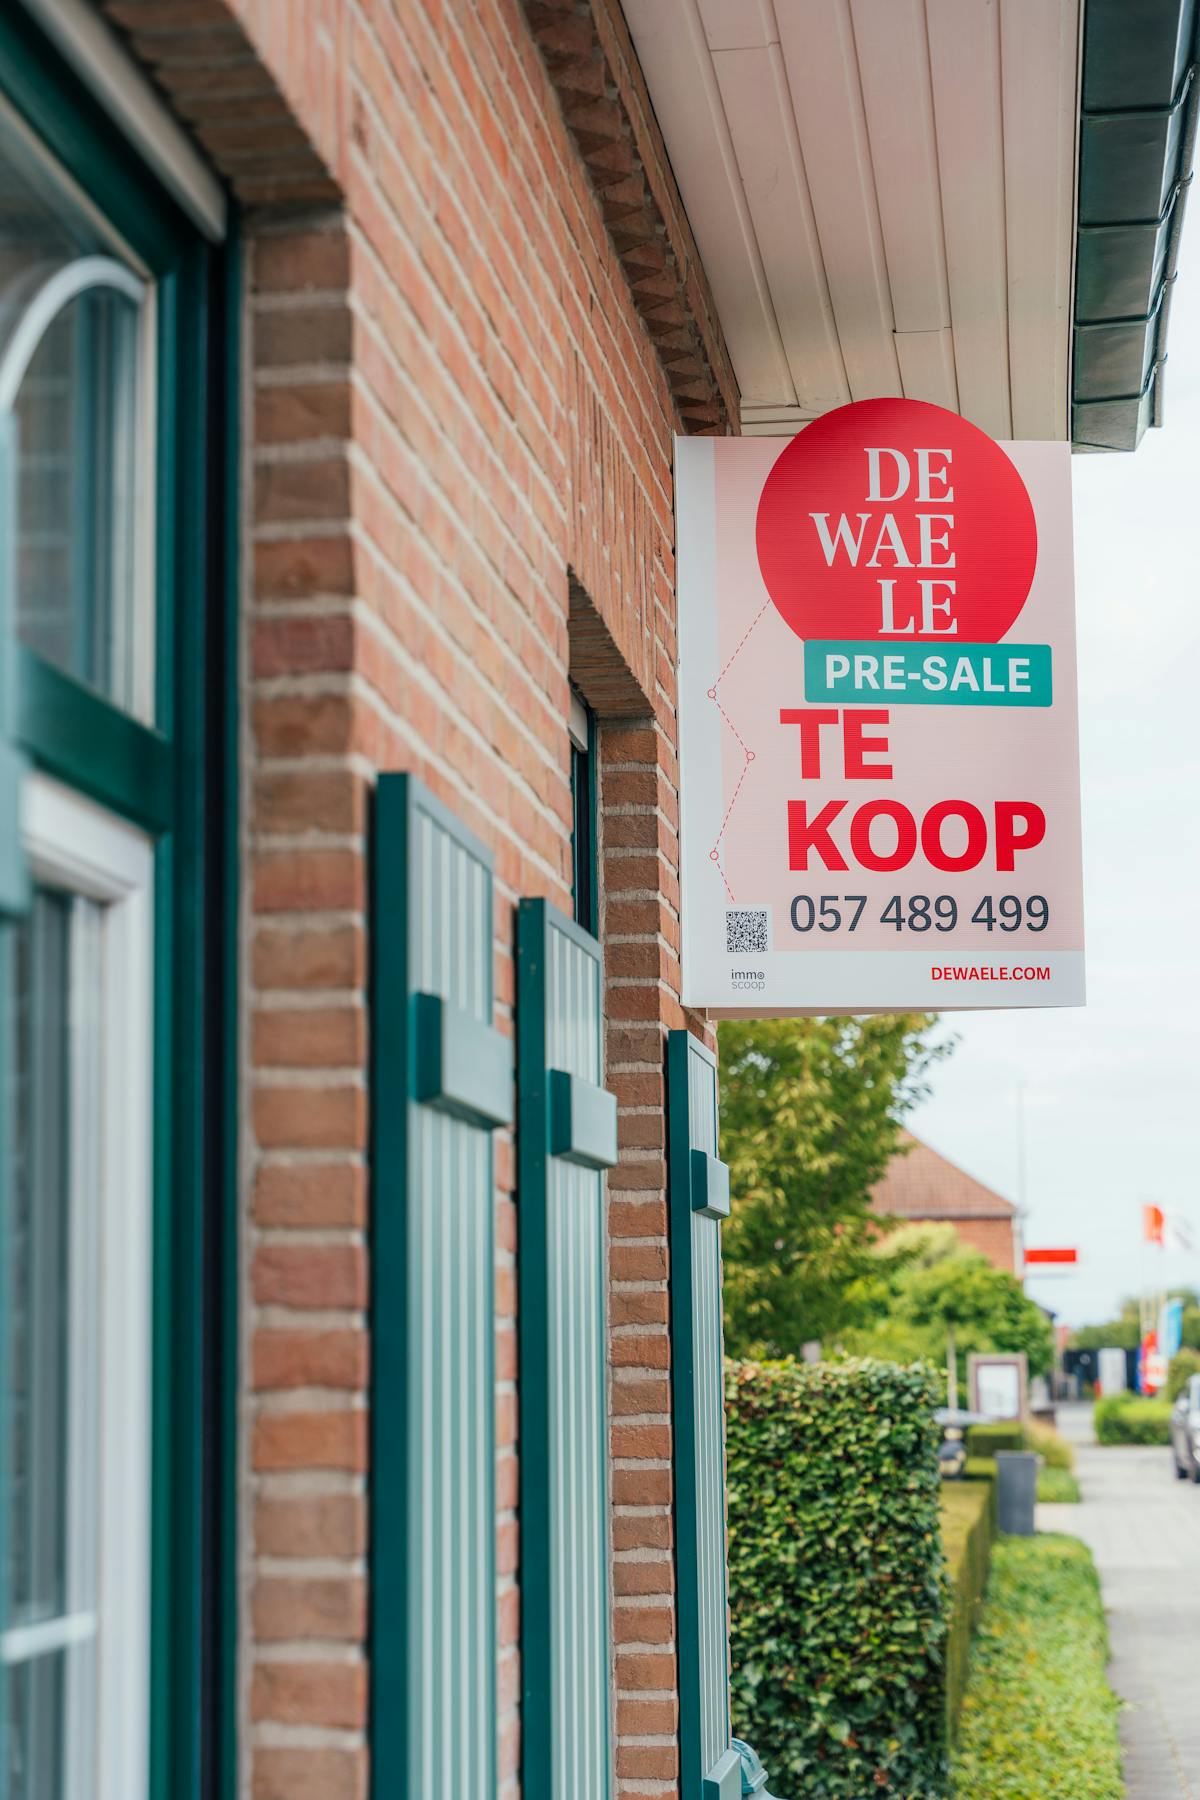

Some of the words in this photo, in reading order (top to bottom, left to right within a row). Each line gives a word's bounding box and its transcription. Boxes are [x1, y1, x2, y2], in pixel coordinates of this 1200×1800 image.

[863, 447, 954, 503] DE
[808, 512, 956, 568] WAE
[876, 579, 958, 634] LE
[825, 654, 1032, 693] PRE-SALE
[779, 708, 893, 780] TE
[787, 799, 1047, 873] KOOP
[789, 894, 868, 932] 057
[879, 895, 958, 932] 489
[970, 895, 1049, 932] 499
[731, 980, 765, 991] scoop
[931, 966, 1051, 981] DEWAELE.COM
